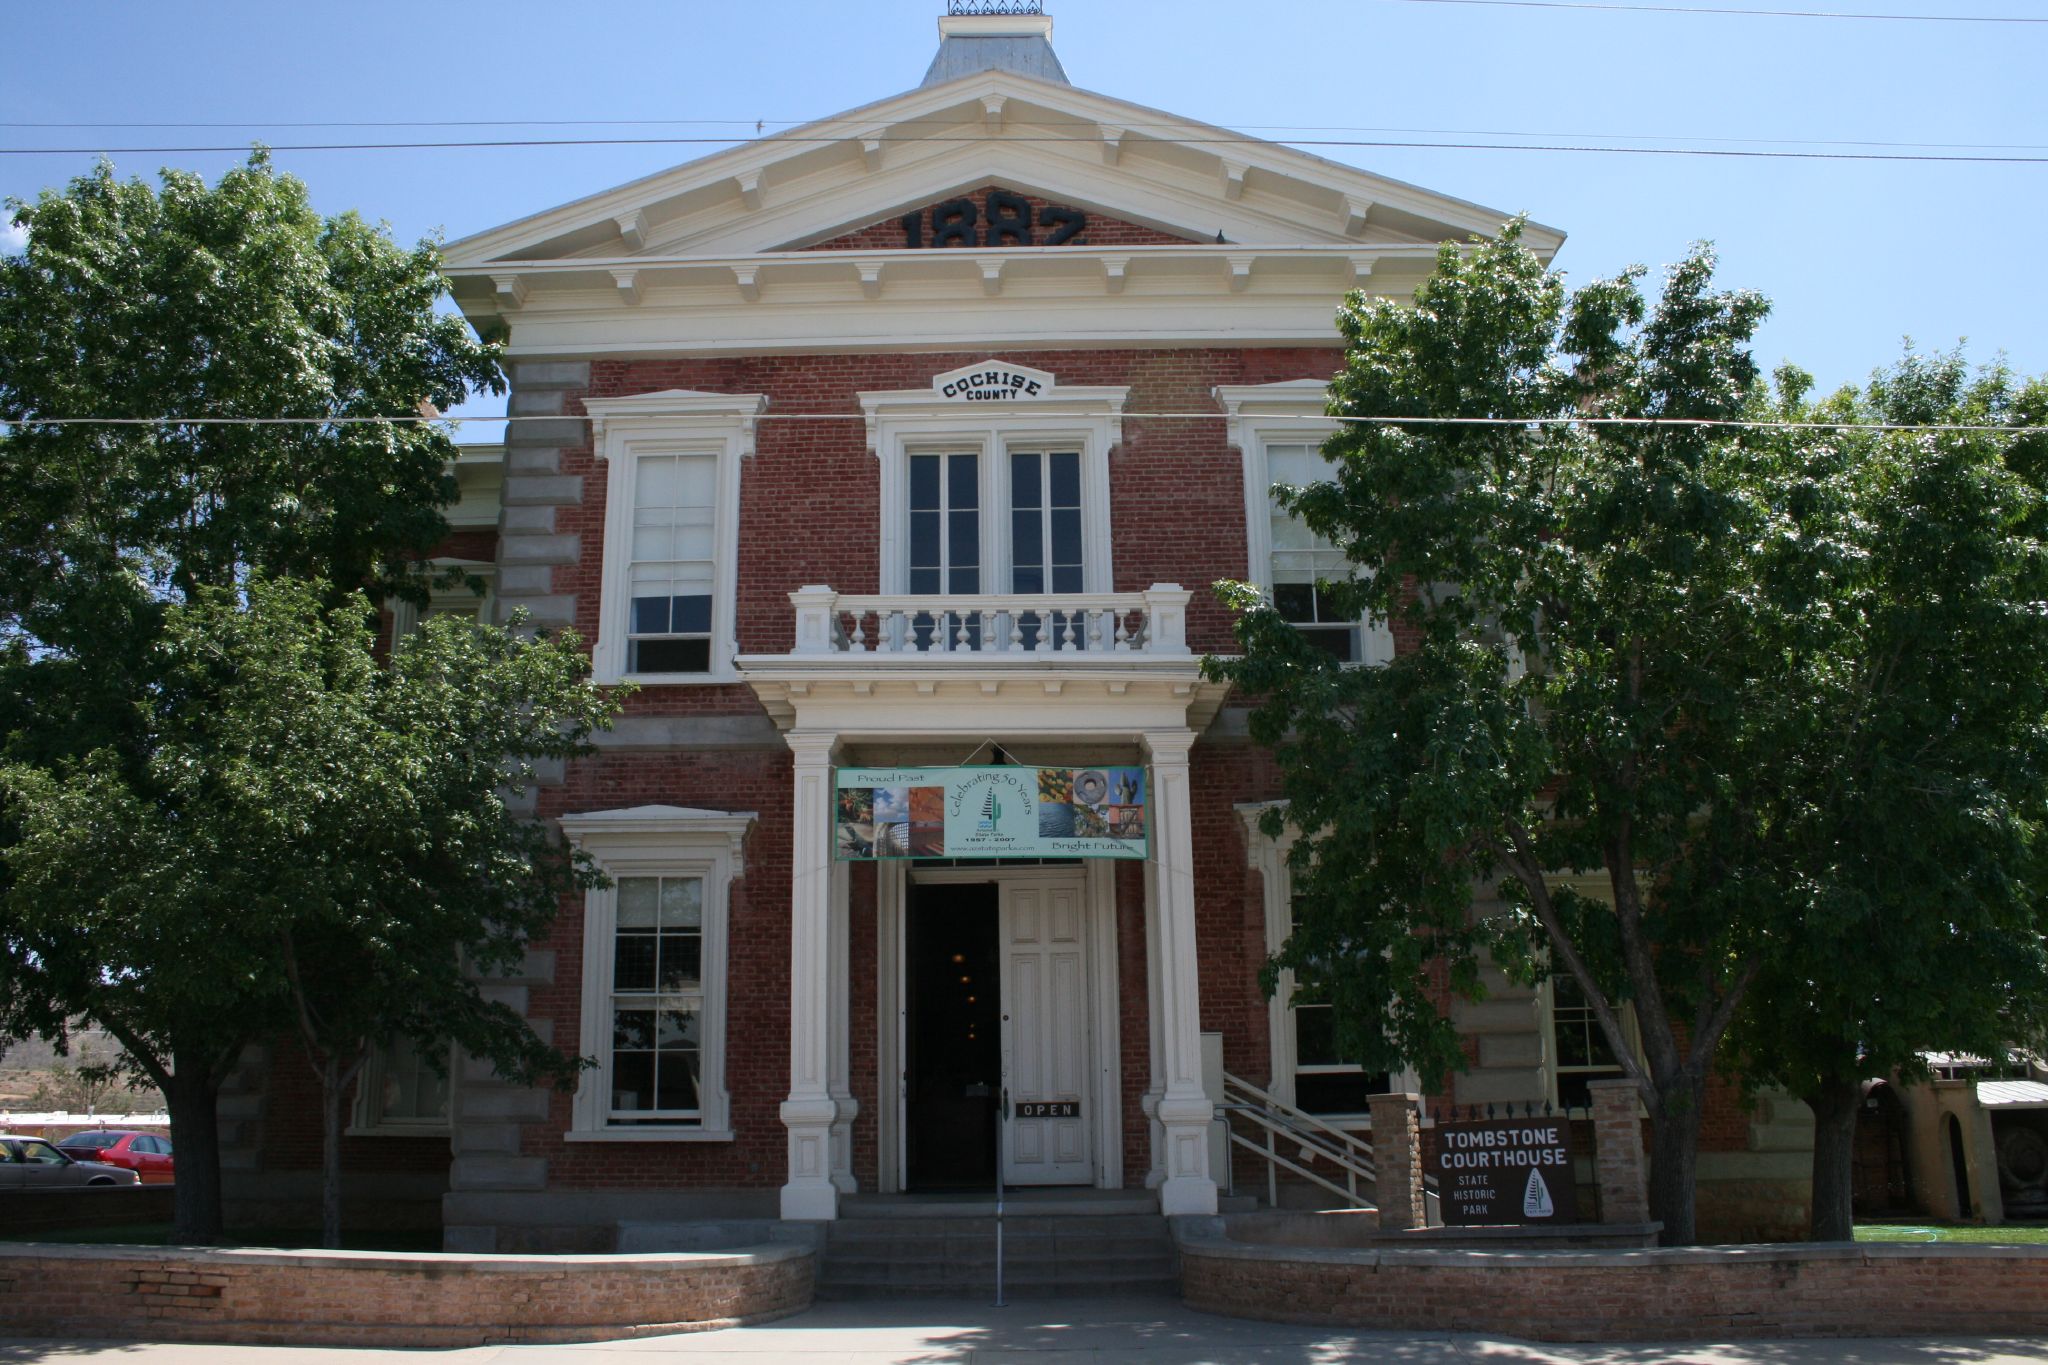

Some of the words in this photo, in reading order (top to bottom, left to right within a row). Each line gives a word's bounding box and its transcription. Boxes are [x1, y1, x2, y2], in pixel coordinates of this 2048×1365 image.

[903, 191, 1087, 247] 1882
[942, 371, 1042, 398] COCHISE
[966, 389, 1018, 400] COUNTY
[857, 773, 895, 783] Proud
[898, 774, 924, 782] Past
[950, 773, 1000, 817] Celebrating
[1003, 773, 1017, 785] 50
[1018, 784, 1032, 815] Years
[1052, 841, 1092, 852] Bright
[1094, 842, 1134, 850] Future
[1024, 1105, 1071, 1116] OPEN
[1444, 1128, 1559, 1148] TOMBSTONE
[1440, 1148, 1567, 1169] COURTHOUSE
[1458, 1175, 1488, 1185] STATE
[1453, 1190, 1496, 1200] HISTORIC
[1463, 1205, 1488, 1214] PARK
